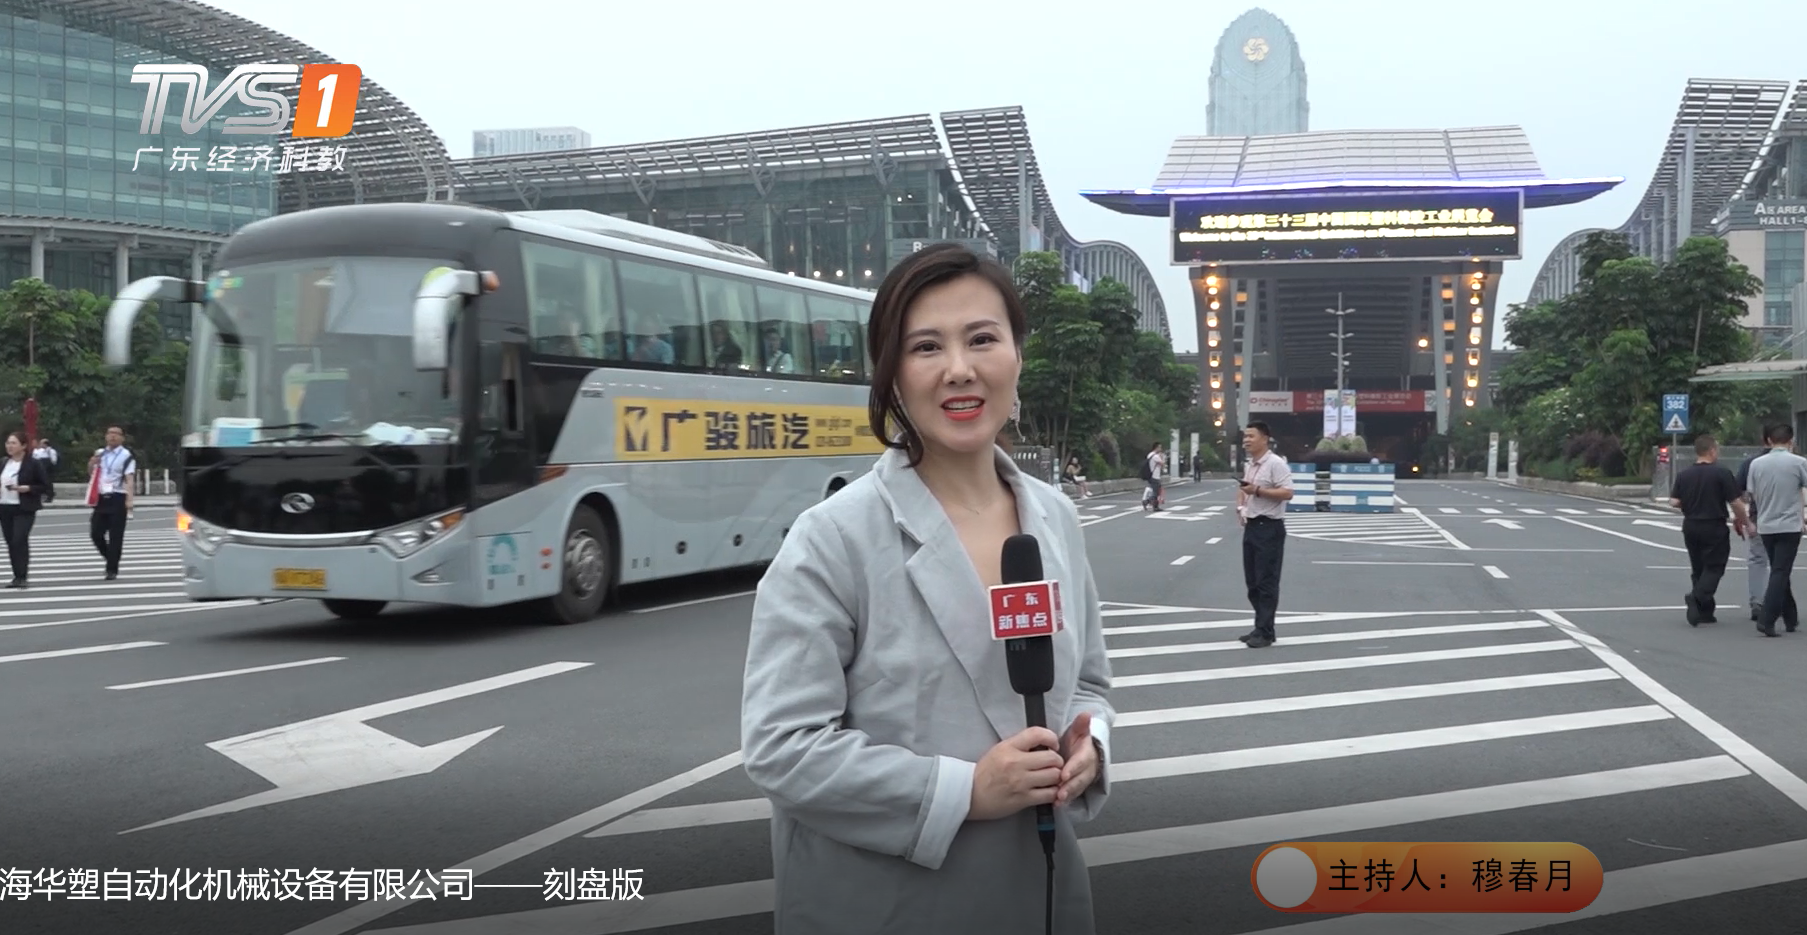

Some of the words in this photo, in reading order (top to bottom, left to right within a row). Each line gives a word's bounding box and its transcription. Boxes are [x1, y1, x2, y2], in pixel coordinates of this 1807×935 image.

[1667, 400, 1685, 409] 382
[660, 410, 810, 452] 广骏旅汽
[1002, 592, 1040, 608] 广东
[998, 612, 1048, 630] 新焦点
